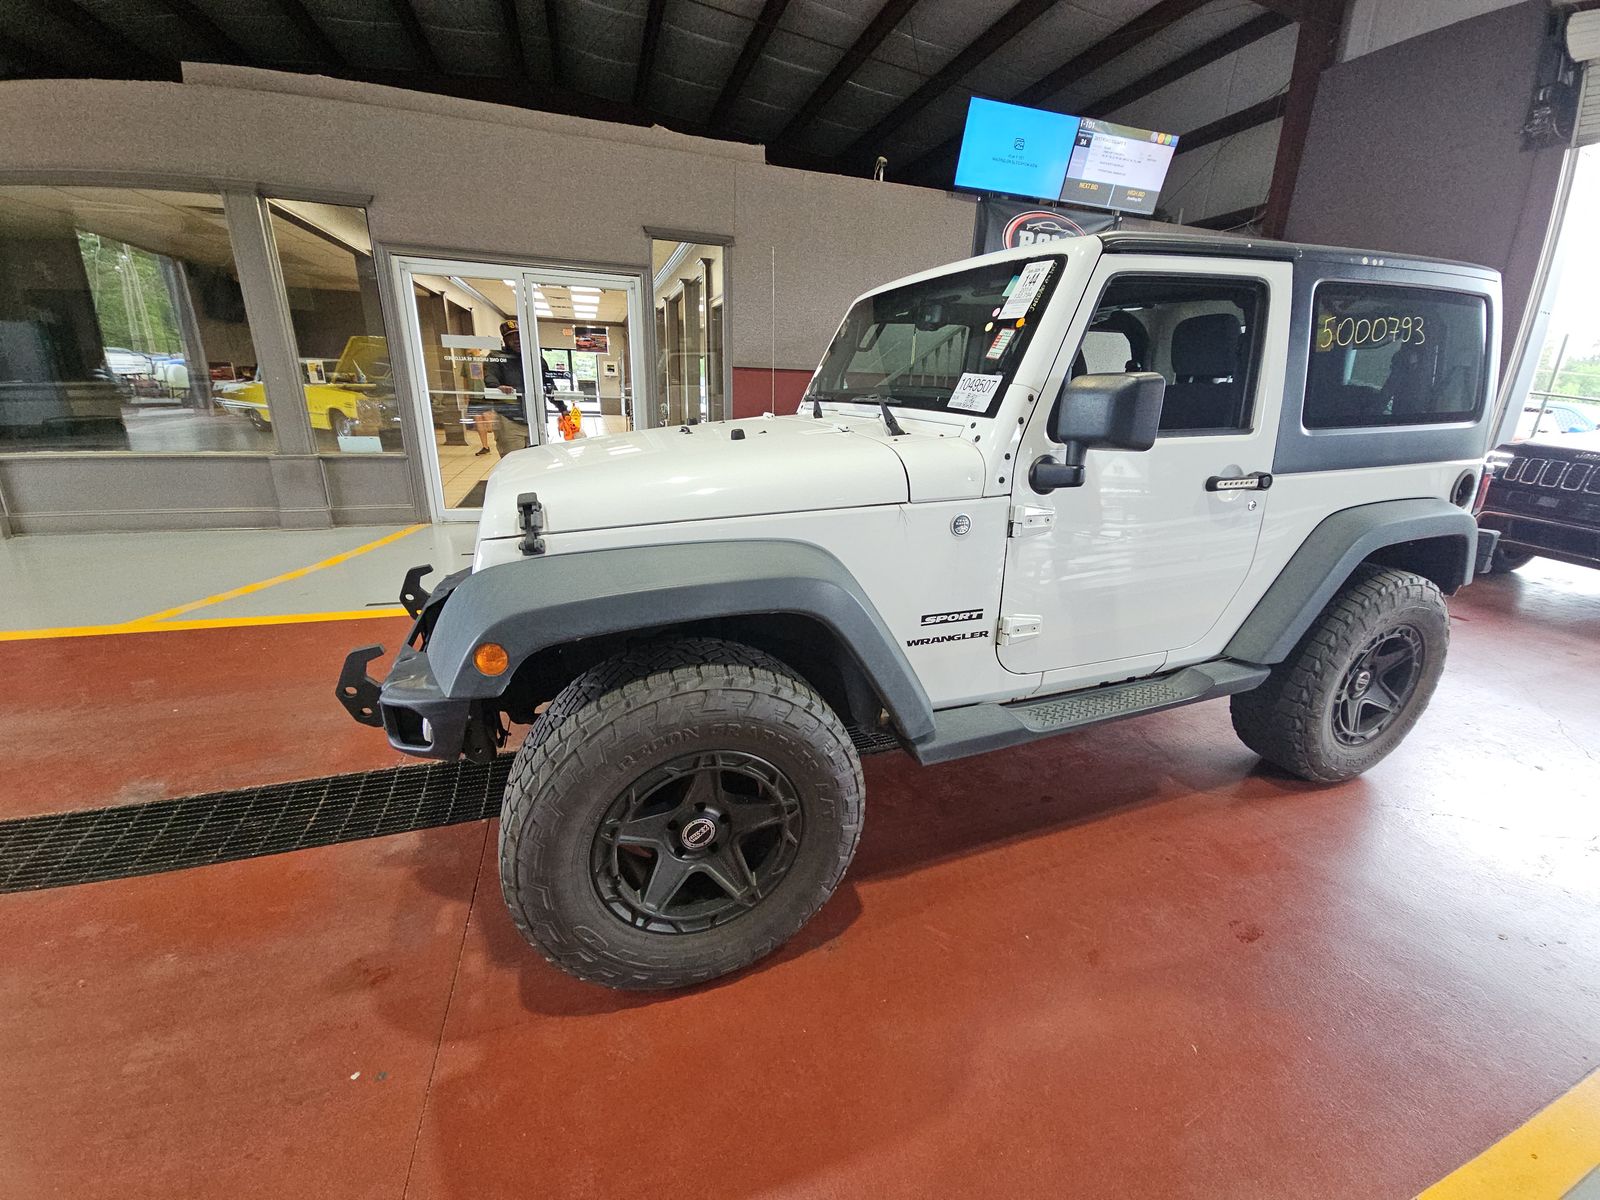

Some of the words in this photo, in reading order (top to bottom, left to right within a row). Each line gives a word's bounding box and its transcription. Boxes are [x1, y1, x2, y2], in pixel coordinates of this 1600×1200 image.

[1320, 316, 1426, 348] 5000793
[959, 377, 998, 393] 1049507
[924, 611, 982, 624] SPORT
[906, 630, 989, 647] WRANGLER
